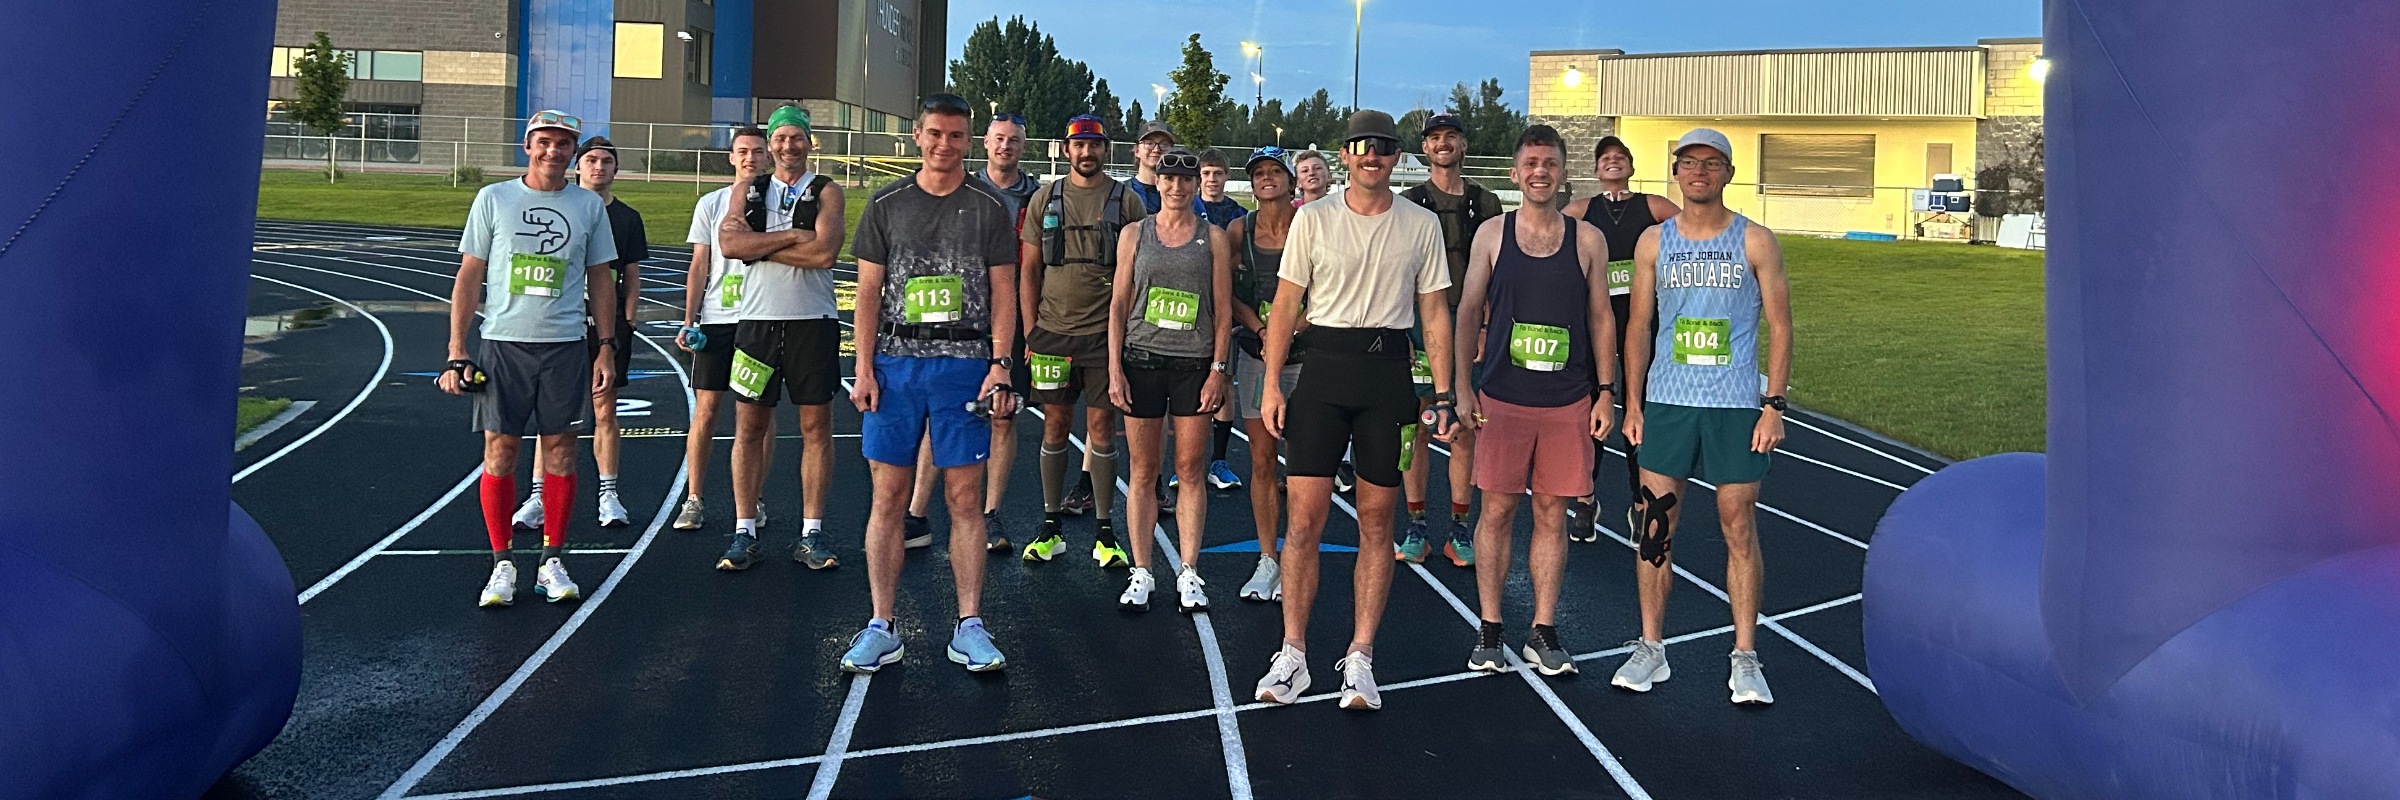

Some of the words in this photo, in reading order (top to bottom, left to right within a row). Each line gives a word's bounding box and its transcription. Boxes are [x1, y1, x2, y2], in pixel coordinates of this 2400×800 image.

[1669, 252, 1692, 262] WEST
[1696, 252, 1732, 260] JORDAN
[523, 266, 555, 282] 102
[1662, 262, 1744, 289] JAGUARS
[916, 289, 951, 306] 113
[1157, 299, 1188, 318] 110
[1523, 337, 1559, 356] 107
[1683, 331, 1719, 350] 104
[733, 362, 759, 385] 101
[1034, 364, 1061, 378] 115
